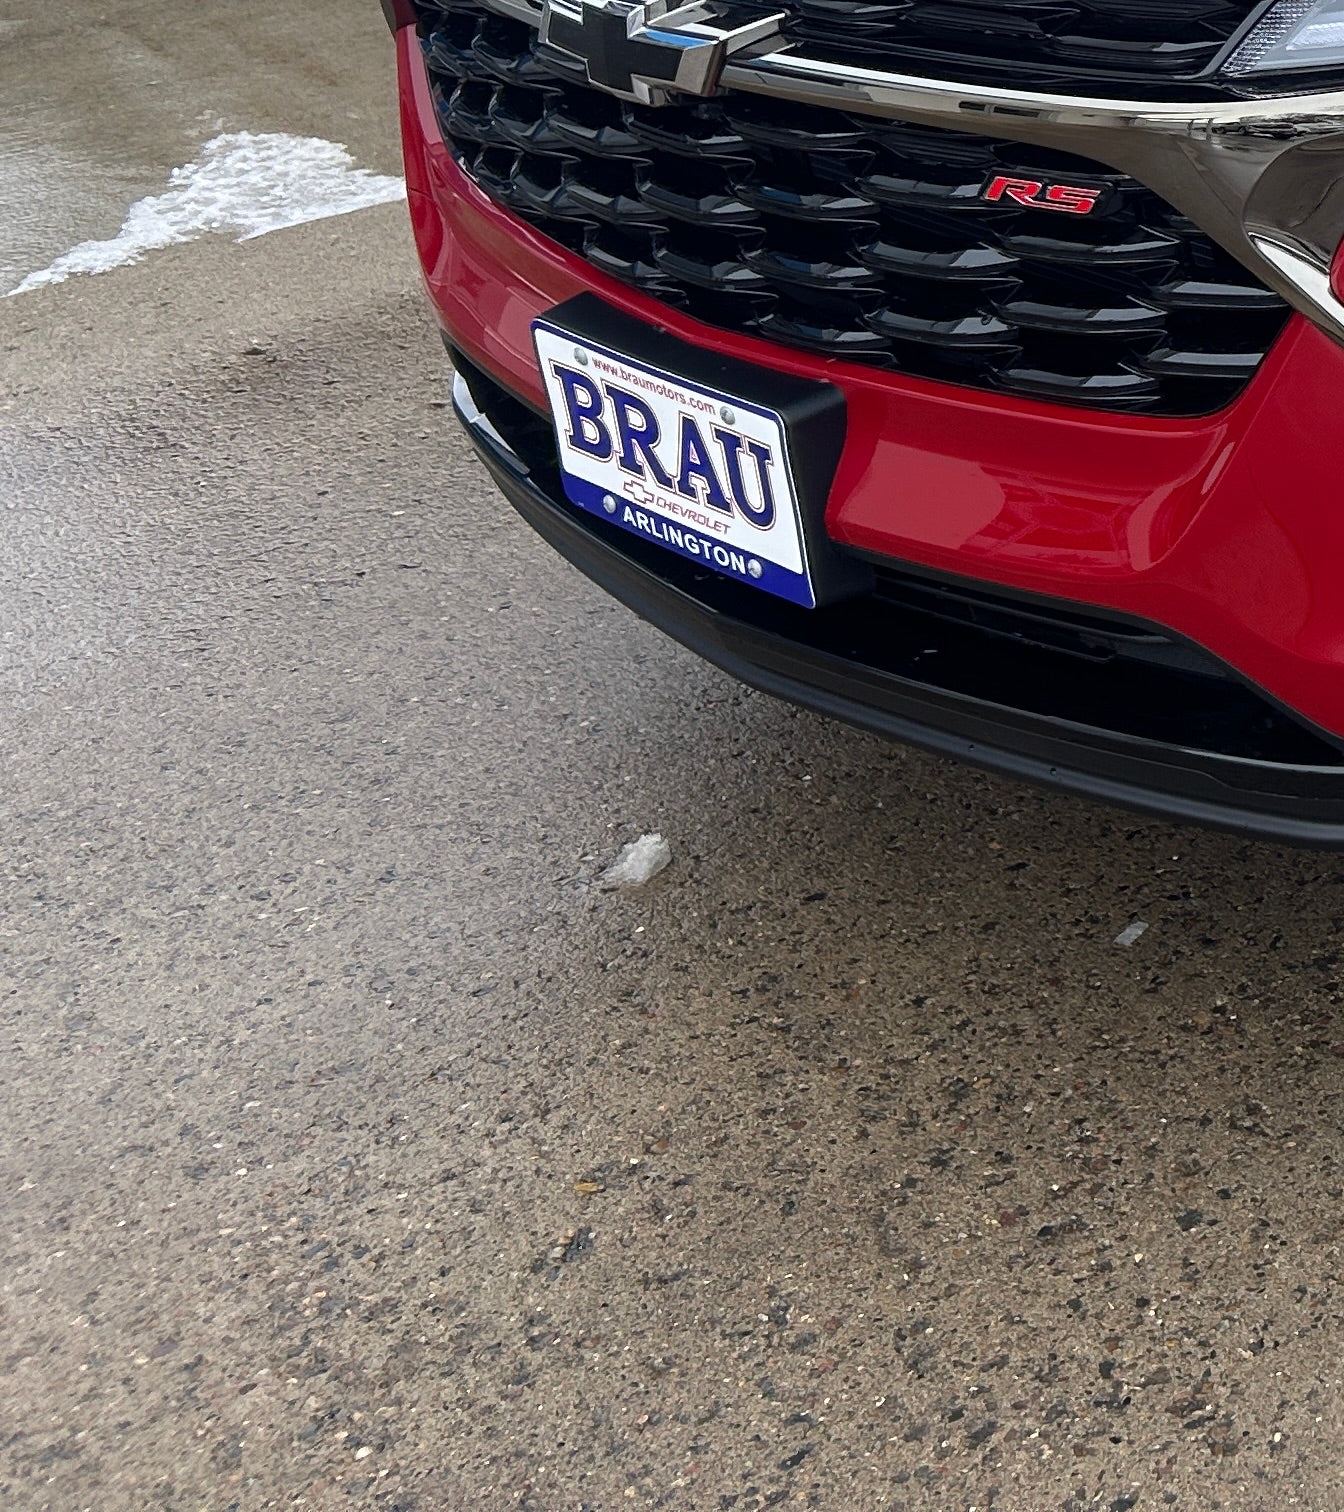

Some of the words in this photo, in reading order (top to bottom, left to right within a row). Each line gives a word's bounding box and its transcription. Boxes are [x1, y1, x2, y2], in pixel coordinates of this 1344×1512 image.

[984, 176, 1101, 214] RS
[592, 356, 716, 416] www.braumotors.com
[548, 358, 777, 531] BRAU
[622, 505, 747, 575] ARLINGTON
[655, 494, 732, 535] CHEVROLET
